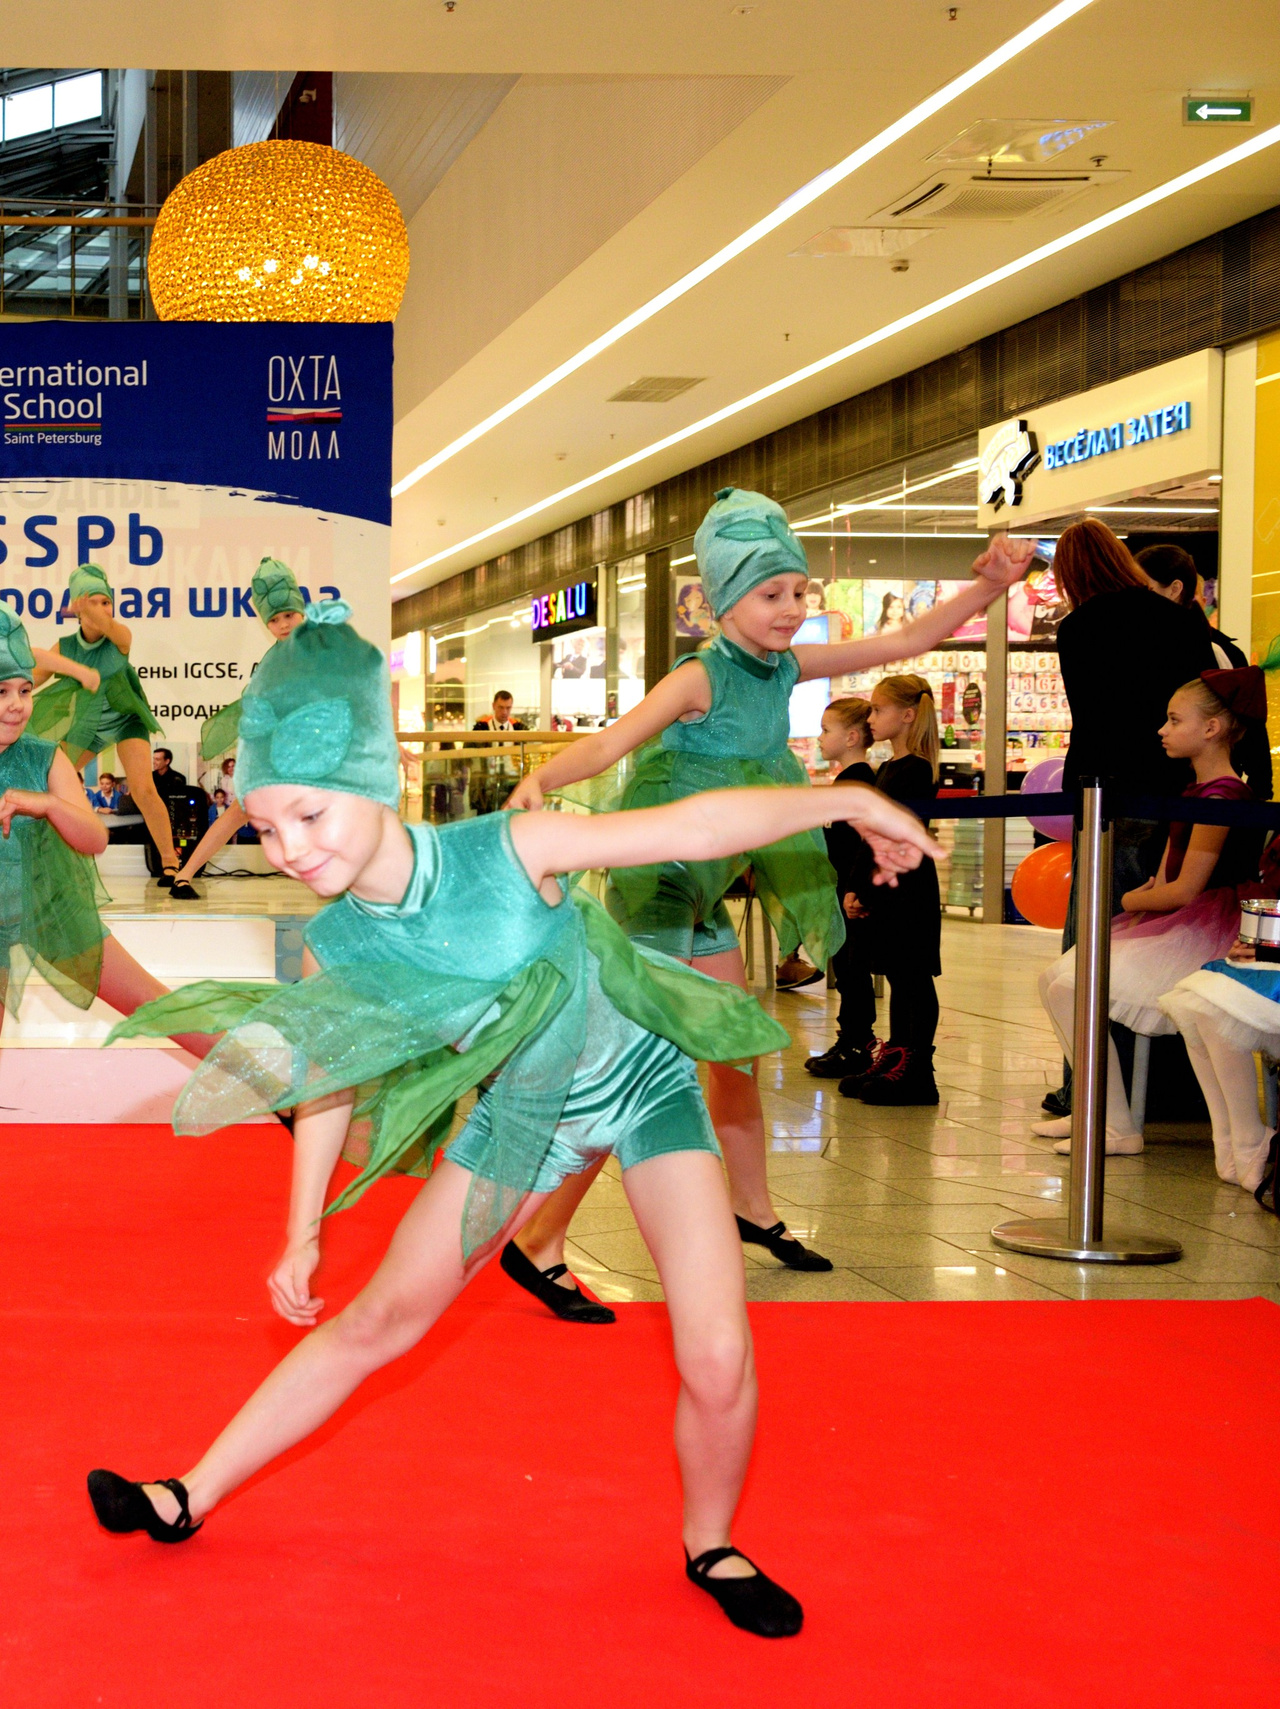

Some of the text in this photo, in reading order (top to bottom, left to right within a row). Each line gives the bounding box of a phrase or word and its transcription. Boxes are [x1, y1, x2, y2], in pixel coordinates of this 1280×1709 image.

[268, 354, 342, 402] ОХТА
[3, 392, 103, 420] School
[3, 432, 103, 447] Saint Petersburg
[1043, 424, 1124, 471] ВЕСЁЛАЯ
[1125, 401, 1191, 447] ЗАТЕЯ
[531, 581, 587, 631] DESALU
[184, 662, 244, 680] IGCSE,
